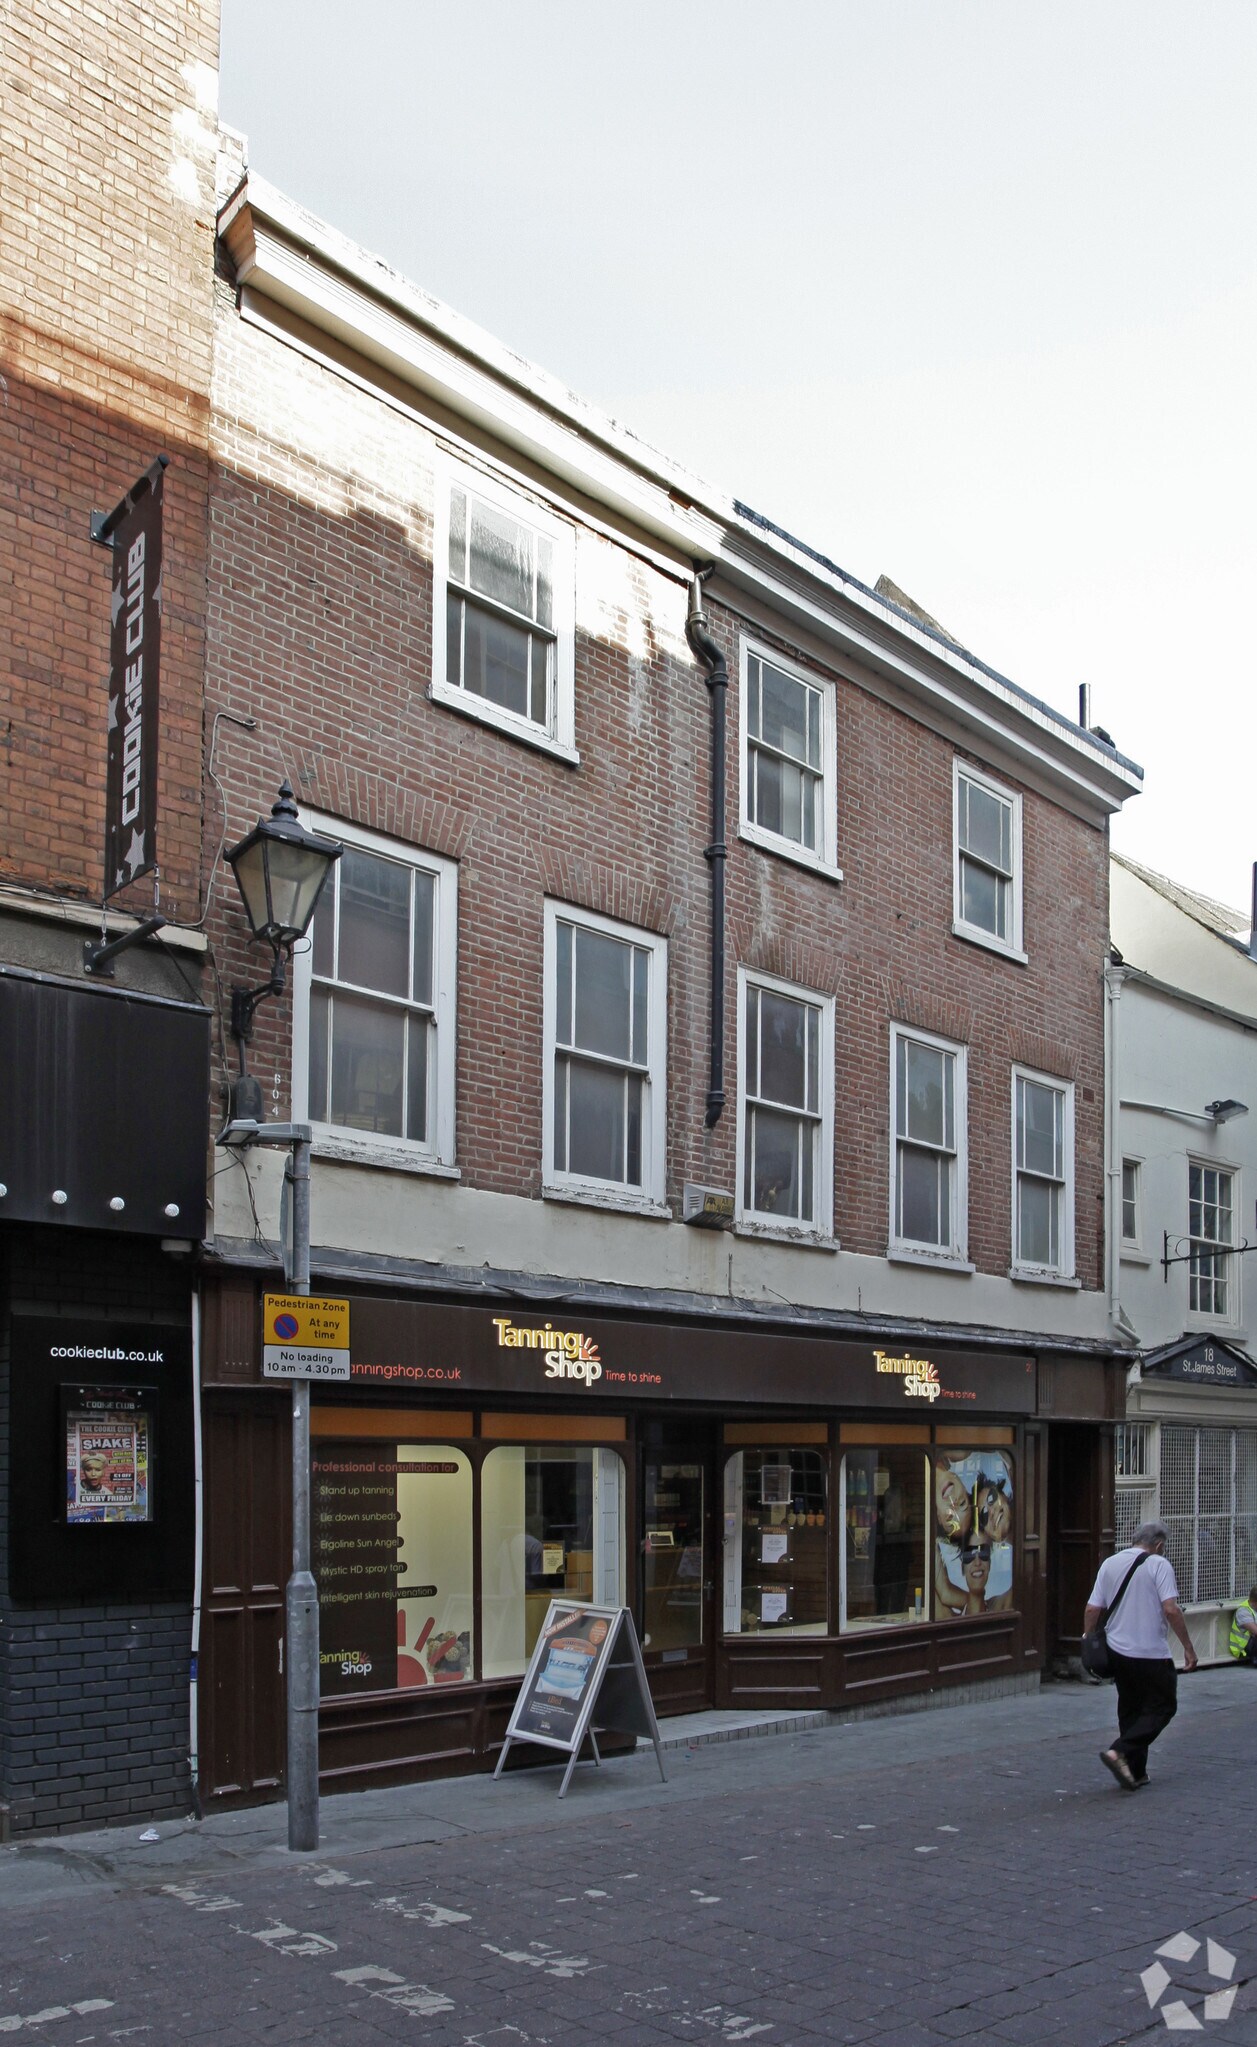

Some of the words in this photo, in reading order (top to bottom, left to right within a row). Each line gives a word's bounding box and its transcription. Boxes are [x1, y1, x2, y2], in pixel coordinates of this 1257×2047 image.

[126, 531, 146, 656] CLUB
[122, 654, 143, 826] COOKIE
[267, 1297, 320, 1310] Pedestrian
[322, 1301, 346, 1312] Zone
[309, 1318, 321, 1327] At
[323, 1319, 340, 1330] any
[314, 1330, 336, 1340] time
[492, 1318, 581, 1359] Tanning
[50, 1345, 164, 1362] cookieclub.co.uk
[280, 1352, 295, 1361] No
[297, 1352, 333, 1364] loading
[1204, 1347, 1214, 1362] 18
[545, 1350, 602, 1387] Shop
[873, 1350, 929, 1382] Tanning
[1216, 1363, 1237, 1377] Street
[605, 1369, 626, 1382] Time
[628, 1372, 638, 1383] to
[639, 1372, 662, 1384] shine
[904, 1374, 941, 1402] Shop
[941, 1388, 955, 1398] Time
[955, 1390, 961, 1399] to
[962, 1390, 977, 1400] shine
[115, 1401, 135, 1410] CLUB
[81, 1425, 93, 1433] THE
[93, 1425, 116, 1433] COOKIE
[83, 1438, 132, 1450] SHAKE
[312, 1461, 376, 1473] Professional
[378, 1461, 439, 1473] consultation
[441, 1461, 455, 1473] for
[320, 1485, 346, 1496] Stand
[348, 1487, 360, 1497] up
[362, 1485, 395, 1497] tanning
[320, 1512, 333, 1522] Lie
[334, 1511, 360, 1521] down
[361, 1511, 397, 1522] sunbeds
[320, 1539, 355, 1551] Ergoline
[357, 1538, 373, 1548] Sun
[374, 1538, 401, 1550] Angel
[320, 1565, 348, 1577] Mystic
[350, 1564, 363, 1574] HD
[365, 1564, 388, 1575] spray
[389, 1563, 404, 1572] tan
[320, 1592, 363, 1604] Intelligent
[365, 1590, 380, 1600] skin
[381, 1587, 433, 1600] rejuvenation
[341, 1661, 372, 1676] Shop
